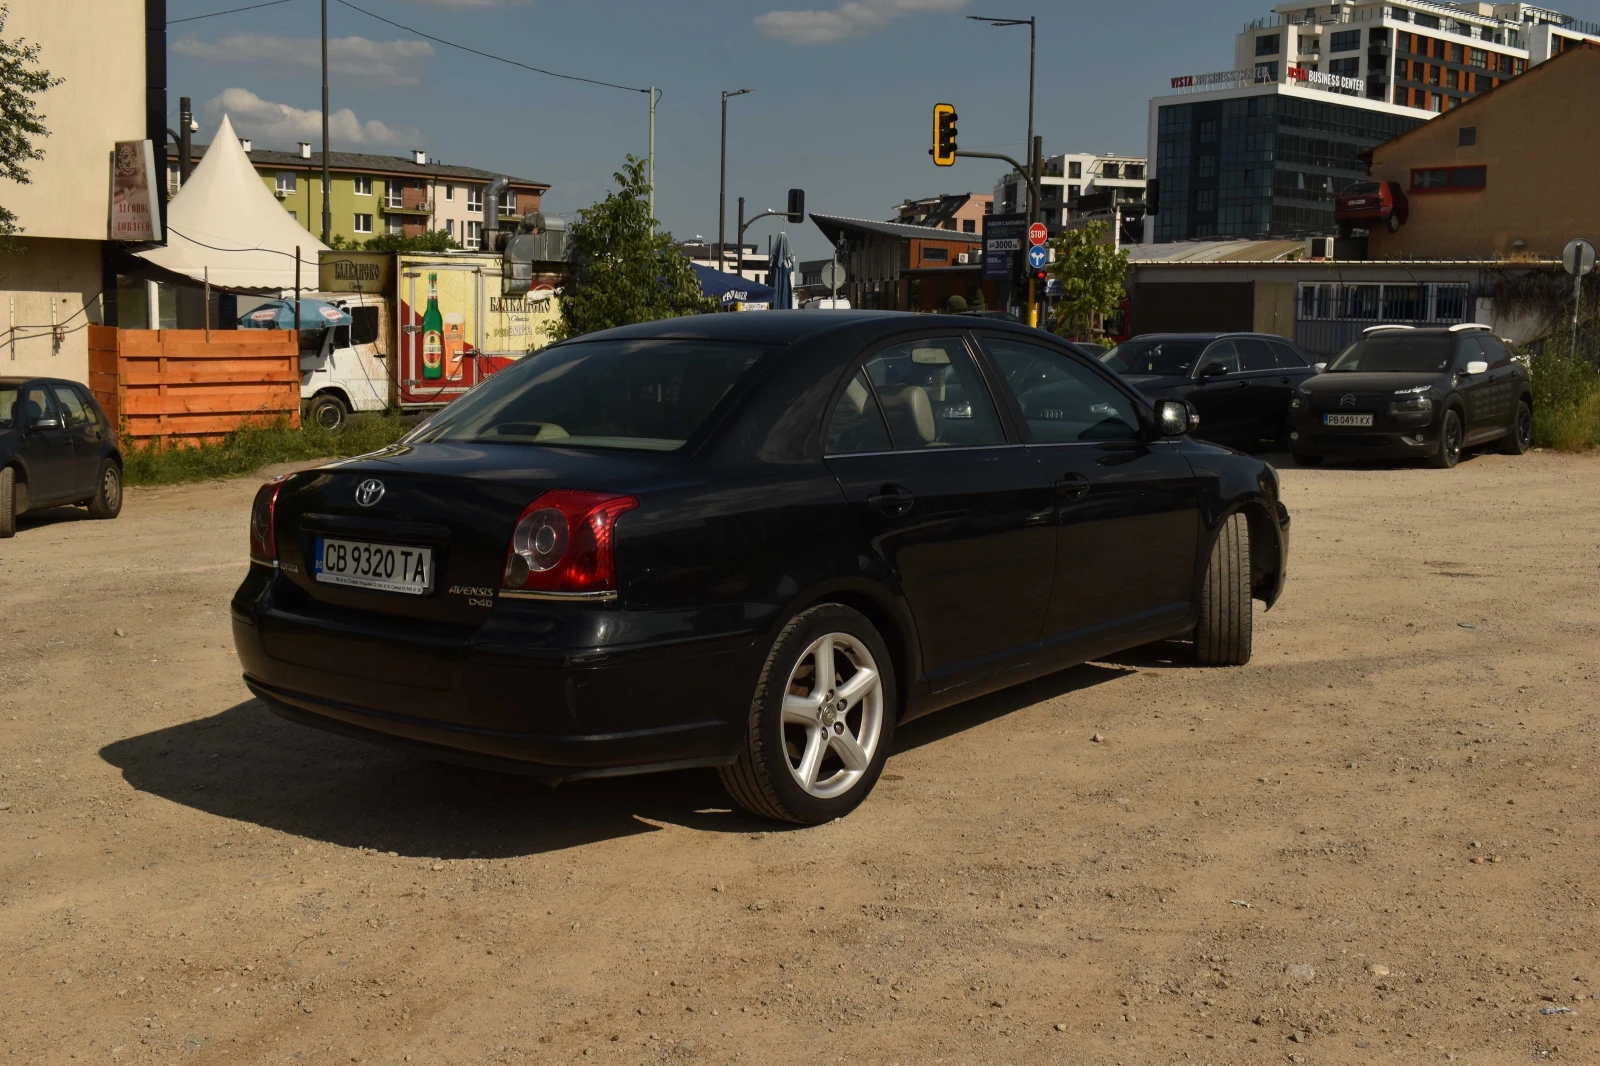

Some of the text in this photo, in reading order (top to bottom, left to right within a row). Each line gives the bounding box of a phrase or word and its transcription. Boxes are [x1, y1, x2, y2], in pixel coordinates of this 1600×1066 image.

[1171, 66, 1269, 89] VISTA BUSINESS CENTER
[1287, 66, 1364, 92] VISTA BUSINESS CENTER
[118, 204, 148, 213] ALCOHOL
[117, 222, 149, 231] TOBACCO
[1030, 230, 1045, 238] STOP
[995, 241, 1012, 249] 3000
[1329, 416, 1338, 424] PB
[1341, 416, 1358, 424] 0491
[1361, 416, 1370, 424] KX
[316, 560, 323, 569] BG
[325, 543, 426, 583] CB 9320 TA
[448, 584, 494, 597] AVENSIS
